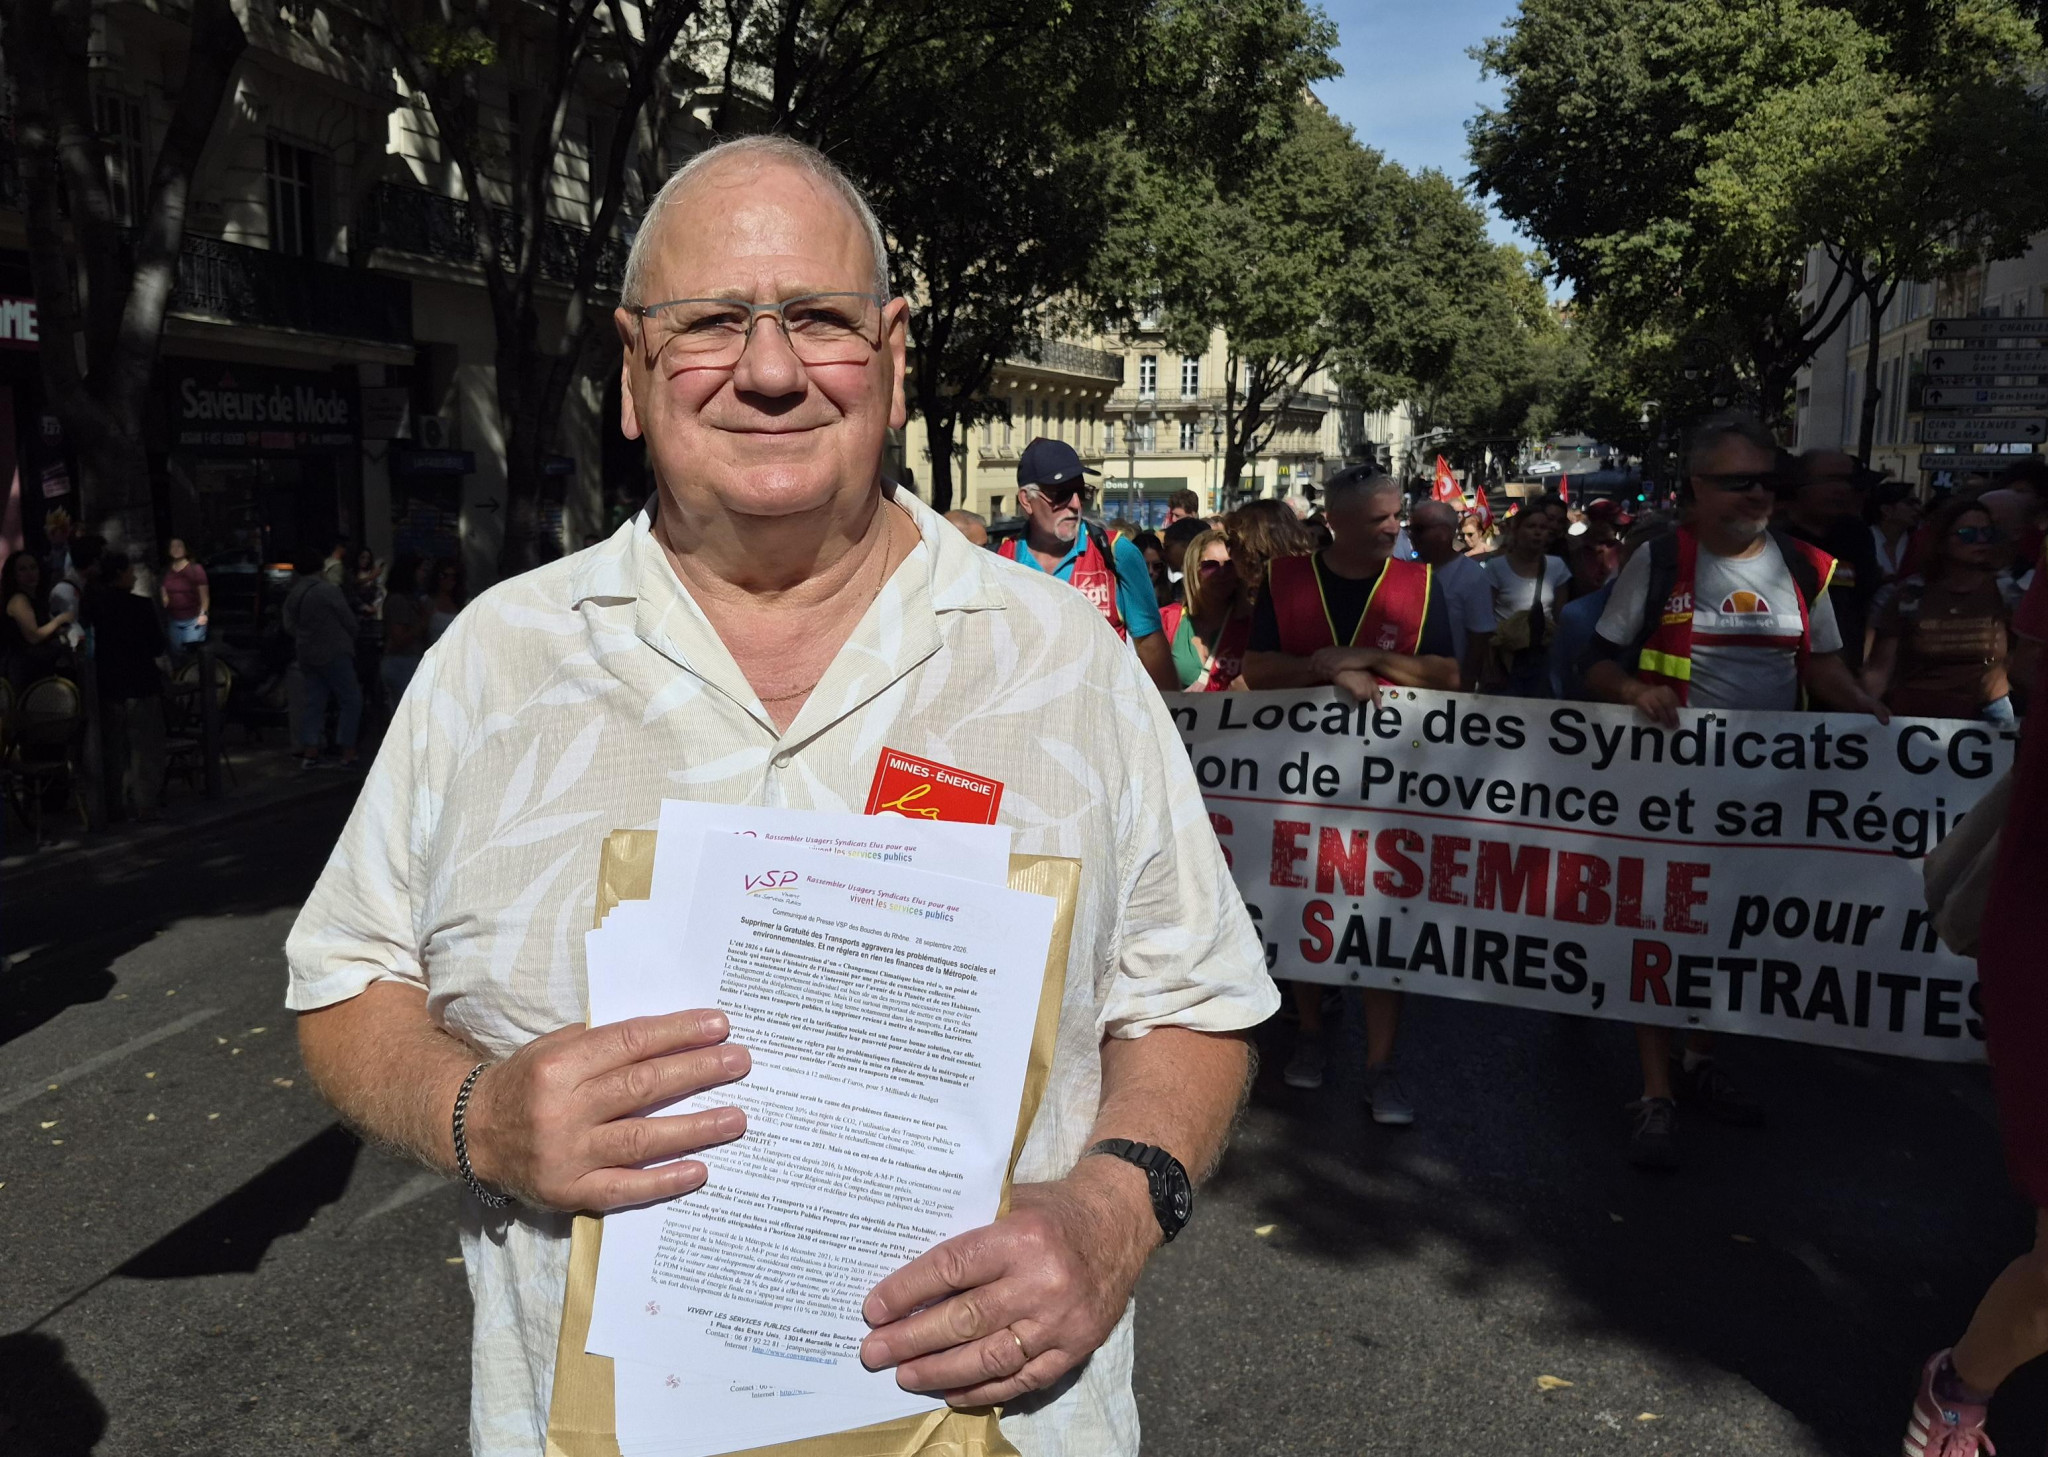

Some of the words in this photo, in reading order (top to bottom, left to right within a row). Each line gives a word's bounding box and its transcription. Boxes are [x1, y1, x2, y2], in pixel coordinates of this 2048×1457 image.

[0, 299, 39, 341] ME
[180, 376, 266, 421] Saveurs
[268, 383, 295, 423] de
[295, 384, 349, 424] Mode
[1927, 431, 1938, 439] LE
[1948, 430, 1987, 439] CAMAS
[1928, 420, 1956, 429] CINQ
[1964, 420, 2017, 429] AVENUES
[1218, 697, 1402, 739] Locale
[1422, 699, 1527, 750] des
[1548, 707, 1869, 771] Syndicats
[1278, 752, 1340, 798] de
[1360, 756, 1618, 826] Provence
[1638, 789, 1695, 834] et
[1715, 799, 1783, 838] sa
[1806, 790, 1968, 858] Régi
[764, 833, 804, 843] Rassembler
[805, 836, 833, 846] Usagers
[835, 838, 867, 849] Syndicats
[869, 841, 884, 850] Elus
[886, 844, 903, 852] pour
[904, 845, 917, 853] que
[883, 851, 913, 863] publics
[744, 870, 799, 891] VSP
[806, 875, 846, 889] Rassembler
[847, 884, 876, 896] Usagers
[876, 890, 910, 902] Syndicats
[911, 896, 926, 906] Elus
[927, 901, 945, 909] pour
[945, 904, 959, 912] que
[1269, 820, 1711, 936] ENSEMBLE
[1728, 894, 1885, 950] pour
[849, 894, 874, 906] vivent
[874, 898, 887, 909] les
[924, 909, 954, 923] publics
[739, 917, 775, 930] Supprimer
[782, 924, 810, 937] Gratuité
[809, 931, 823, 940] des
[823, 933, 860, 947] Transports
[860, 941, 894, 955] aggravera
[894, 948, 905, 957] les
[905, 951, 958, 968] problématiques
[958, 962, 988, 974] sociales
[752, 929, 816, 948] environnementales.
[835, 946, 860, 957] réglera
[869, 954, 883, 962] rien
[883, 956, 895, 965] les
[894, 959, 924, 971] finances
[1299, 899, 1607, 1011] SALAIRES,
[686, 1305, 713, 1317] VIVENT
[713, 1311, 728, 1320] LES
[728, 1314, 762, 1327] SERVICES
[762, 1320, 791, 1332] PUBLICS
[791, 1326, 818, 1337] Collectif
[832, 1333, 856, 1342] Bouches
